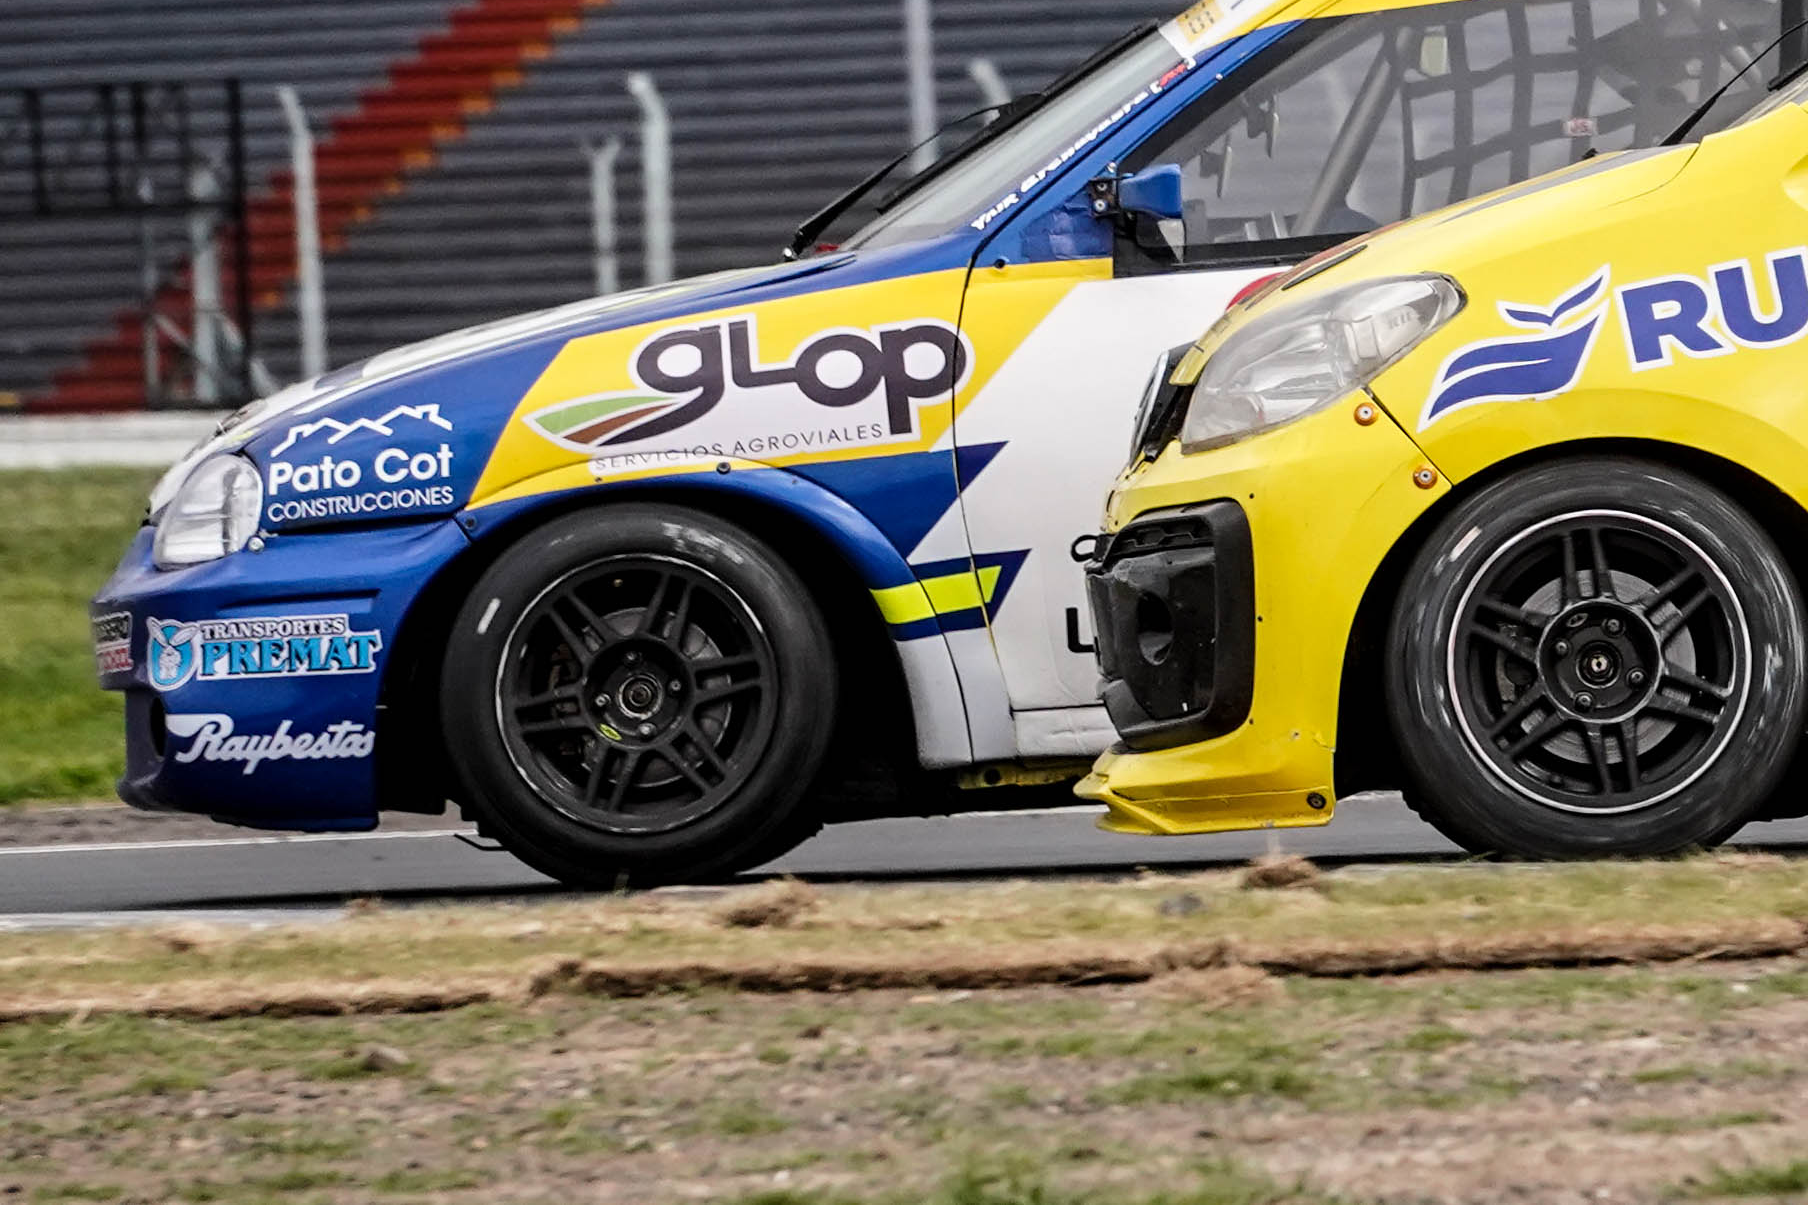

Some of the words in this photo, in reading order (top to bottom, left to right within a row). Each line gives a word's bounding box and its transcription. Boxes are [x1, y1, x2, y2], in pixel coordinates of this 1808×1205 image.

[267, 455, 362, 496] Pato
[374, 443, 454, 484] Cot
[593, 442, 724, 473] SERVICIOS
[731, 422, 884, 456] AGROVIALES
[267, 485, 455, 523] CONSTRUCCIONES
[200, 617, 346, 641] TRANSPORTES
[200, 634, 379, 677] PREMAT
[165, 712, 376, 776] Raybestos
